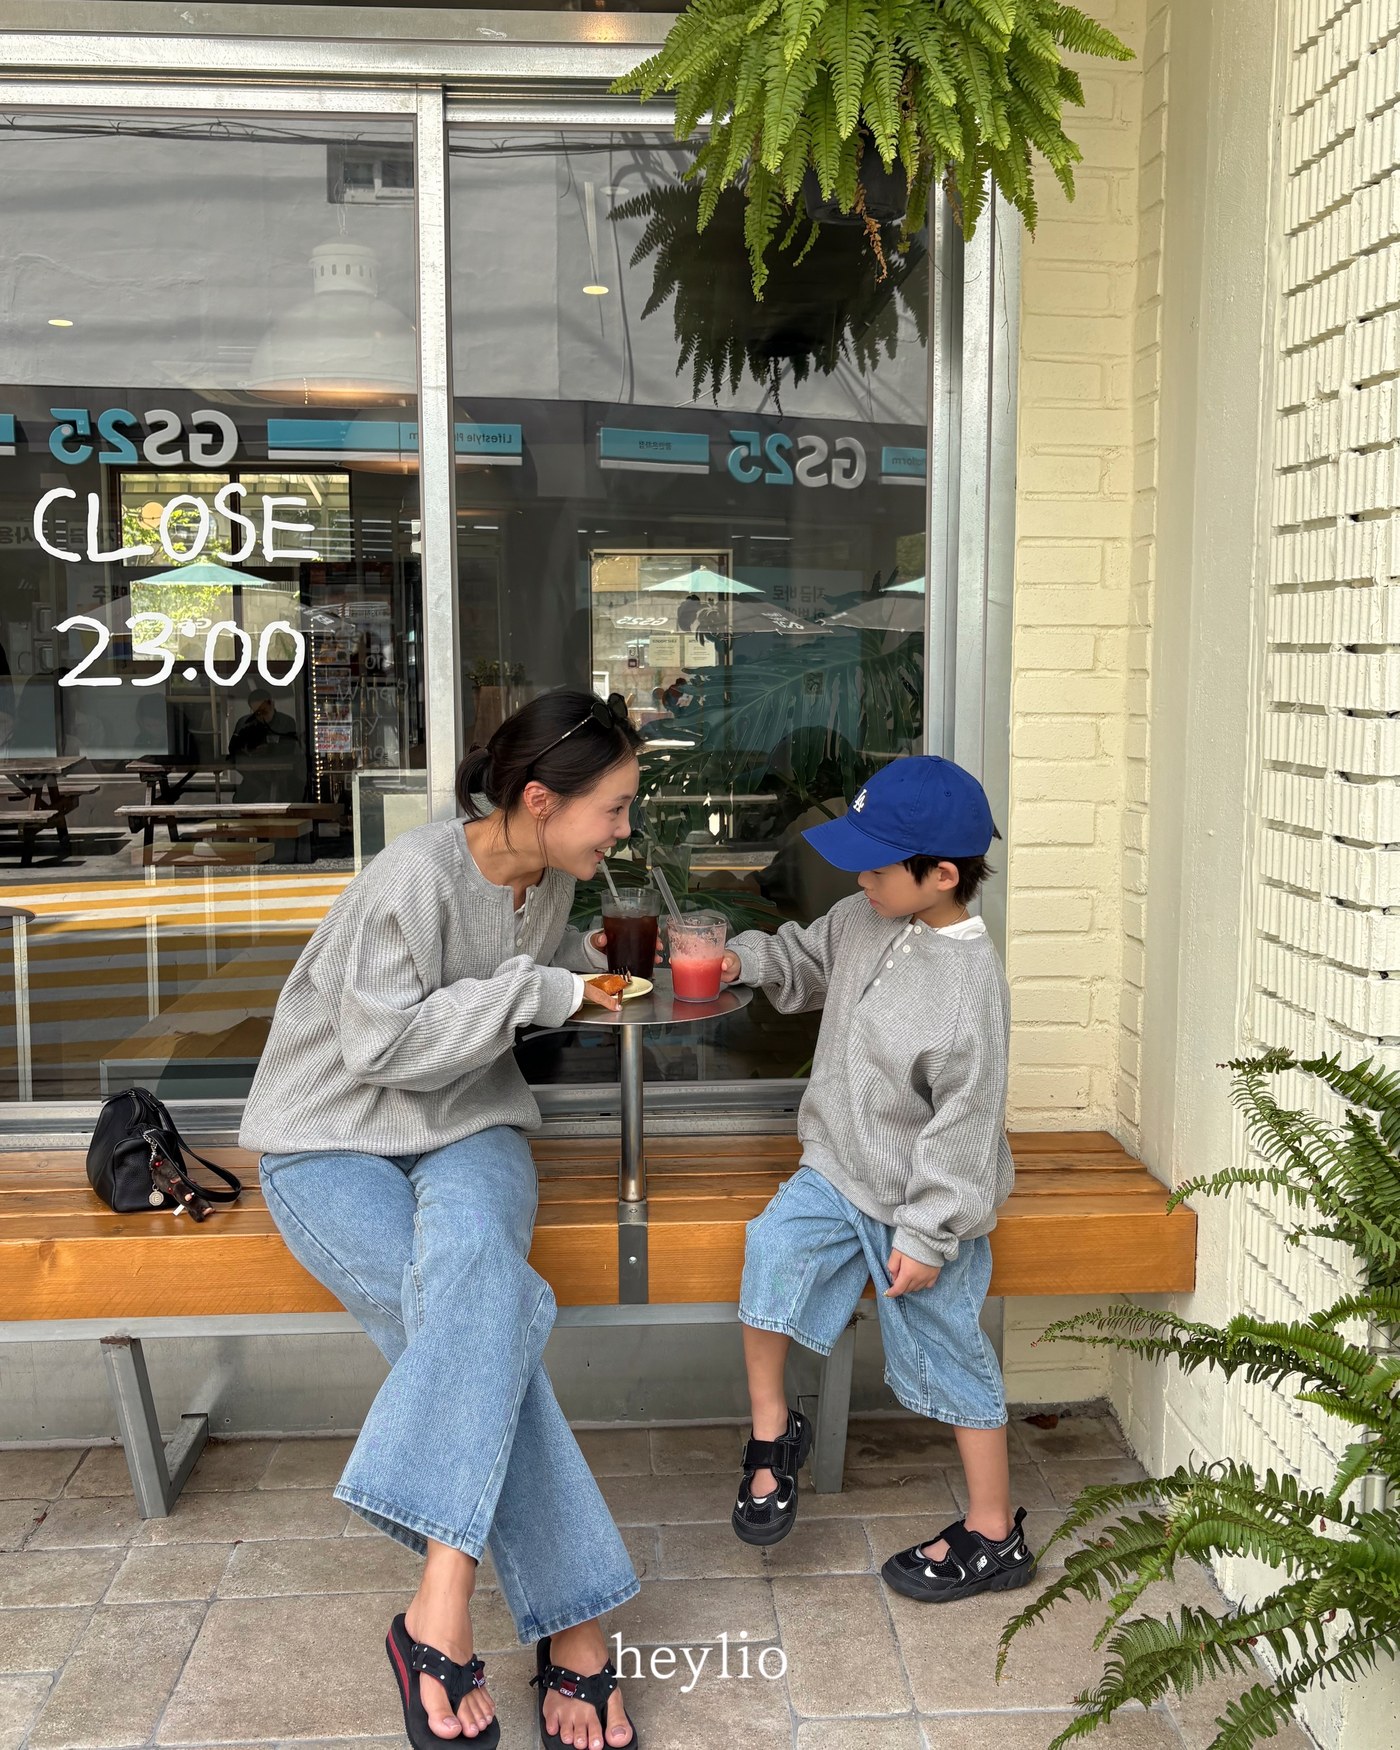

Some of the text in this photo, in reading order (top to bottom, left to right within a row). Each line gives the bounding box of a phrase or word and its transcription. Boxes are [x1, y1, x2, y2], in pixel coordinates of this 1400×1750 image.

[33, 482, 321, 564] CLOSE
[51, 611, 306, 687] 23:00
[852, 788, 868, 813] LA
